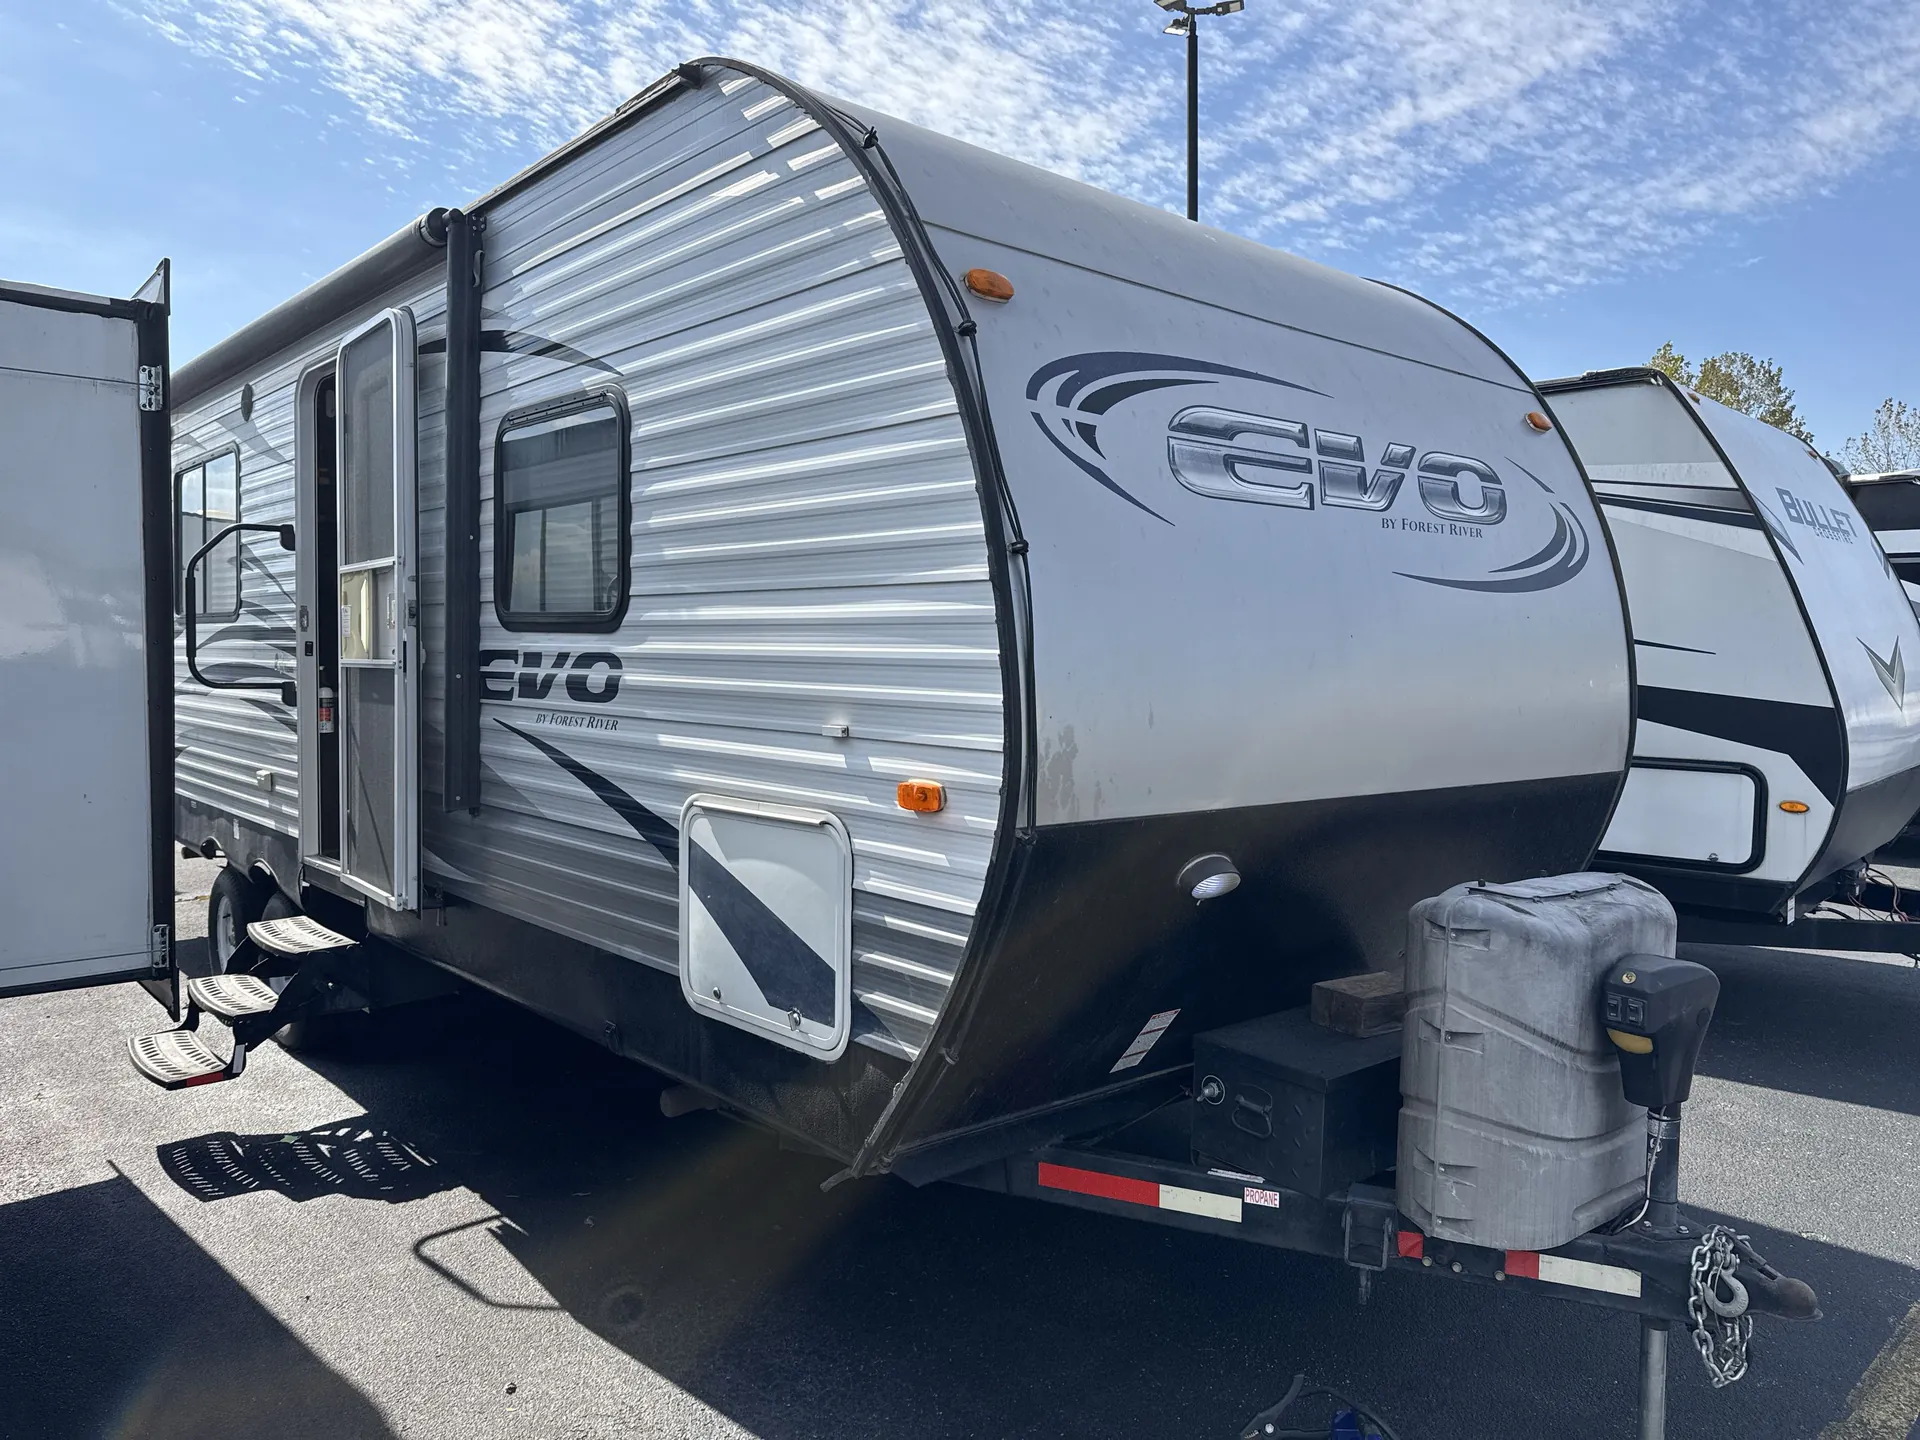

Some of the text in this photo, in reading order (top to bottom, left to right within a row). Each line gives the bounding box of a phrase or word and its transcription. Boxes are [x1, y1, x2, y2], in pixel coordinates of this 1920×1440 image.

[1168, 405, 1507, 525] EVO
[1381, 518, 1483, 538] BY FOREST RIVER
[1775, 487, 1857, 537] BULLET
[480, 650, 623, 703] EVO
[536, 713, 619, 731] BY FOREST RIVER
[1245, 1189, 1278, 1206] PROPANE
